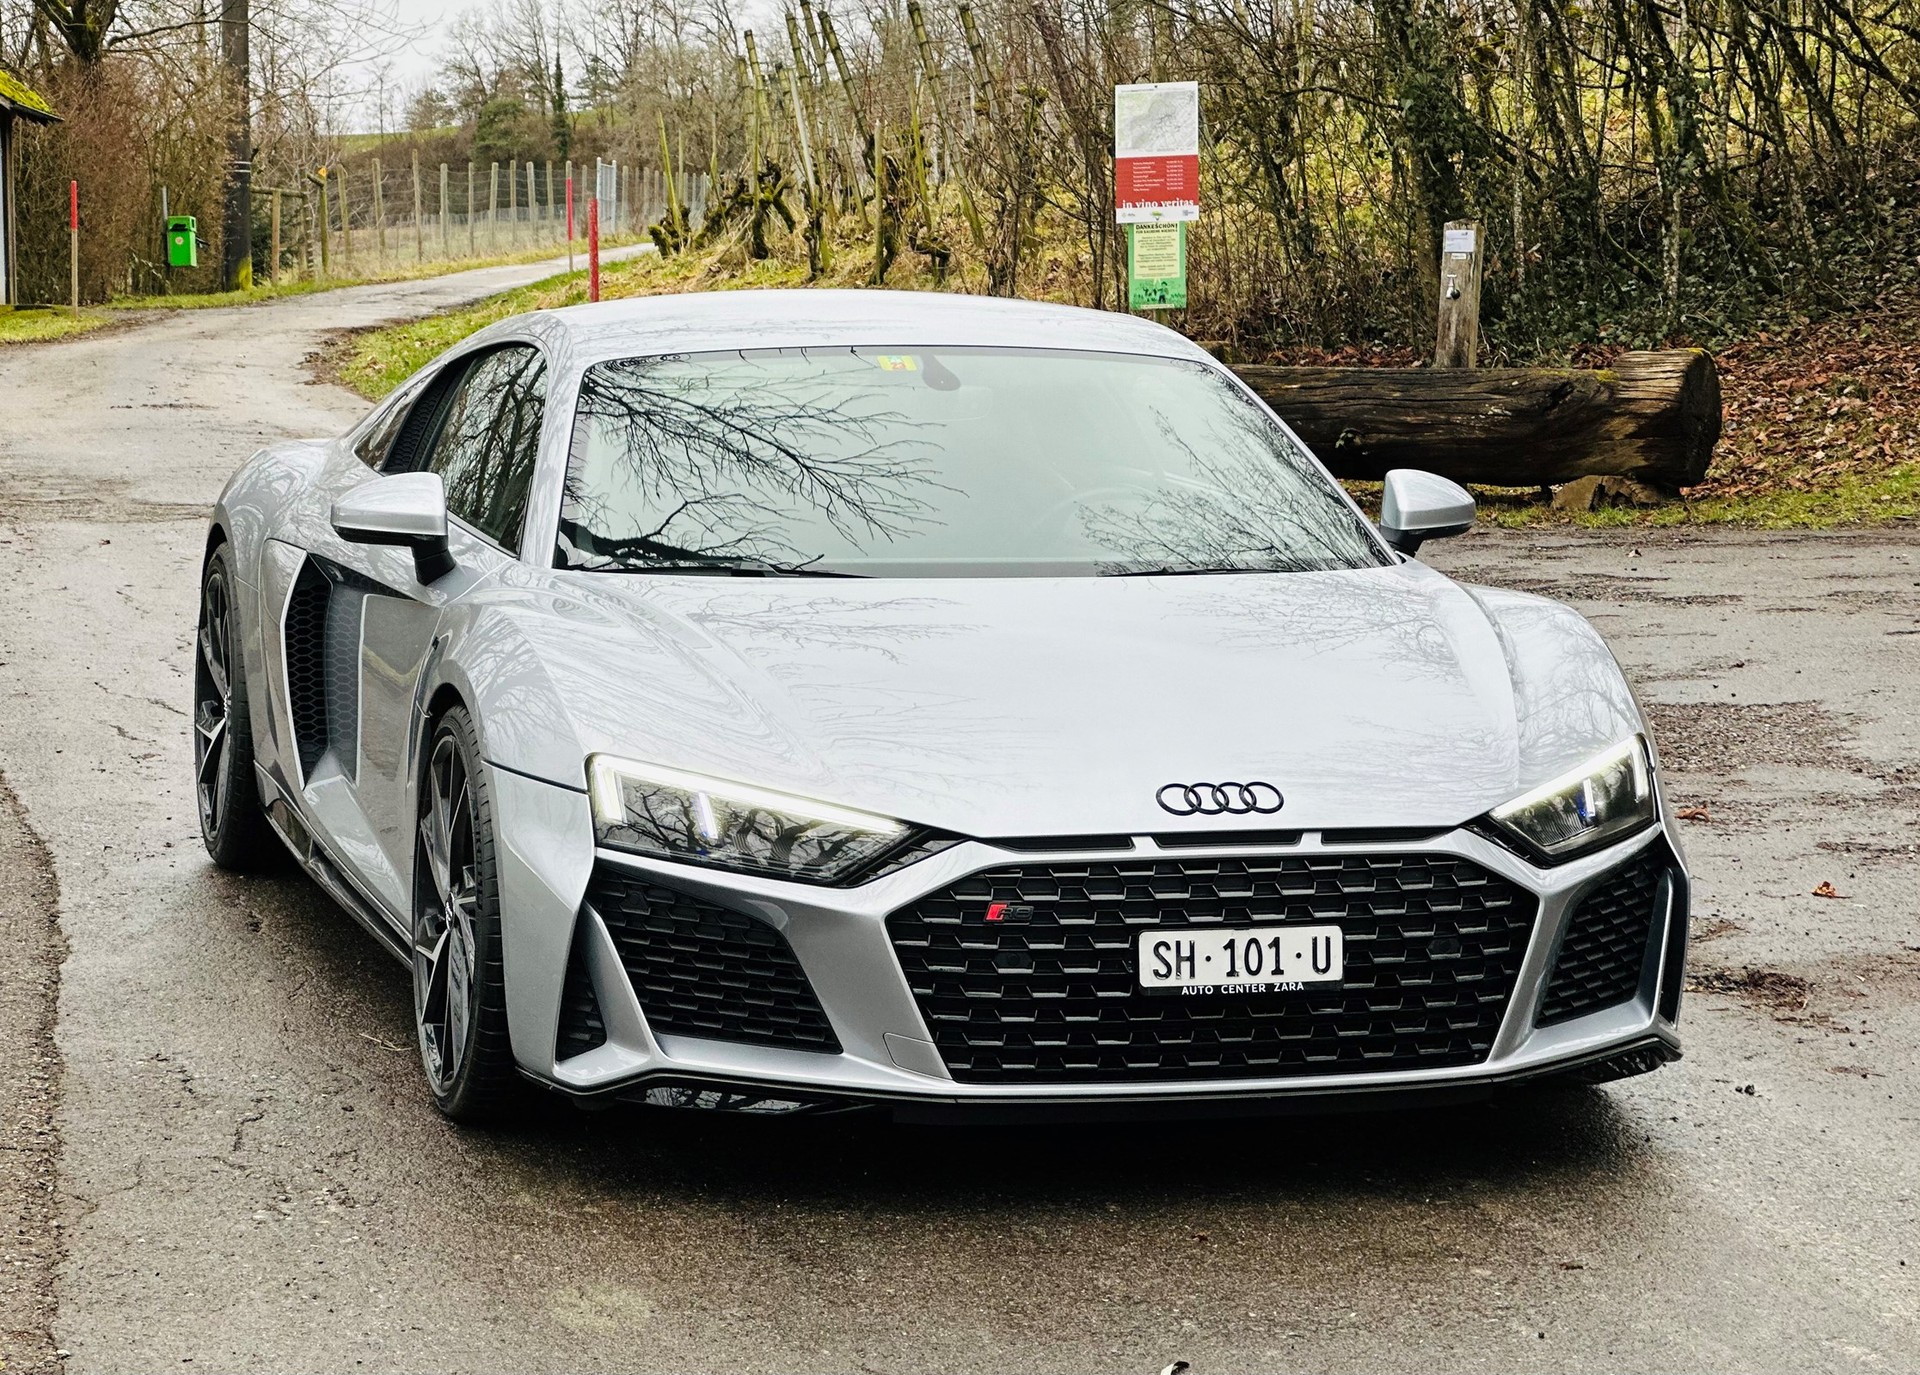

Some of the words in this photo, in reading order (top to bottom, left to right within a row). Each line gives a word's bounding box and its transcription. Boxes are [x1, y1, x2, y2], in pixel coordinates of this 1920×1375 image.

[1122, 200, 1133, 209] in
[1135, 198, 1158, 209] vino
[1160, 197, 1194, 208] veritas
[1181, 985, 1214, 996] AUTO
[1221, 983, 1266, 995] CENTER
[1273, 981, 1305, 993] ZARA
